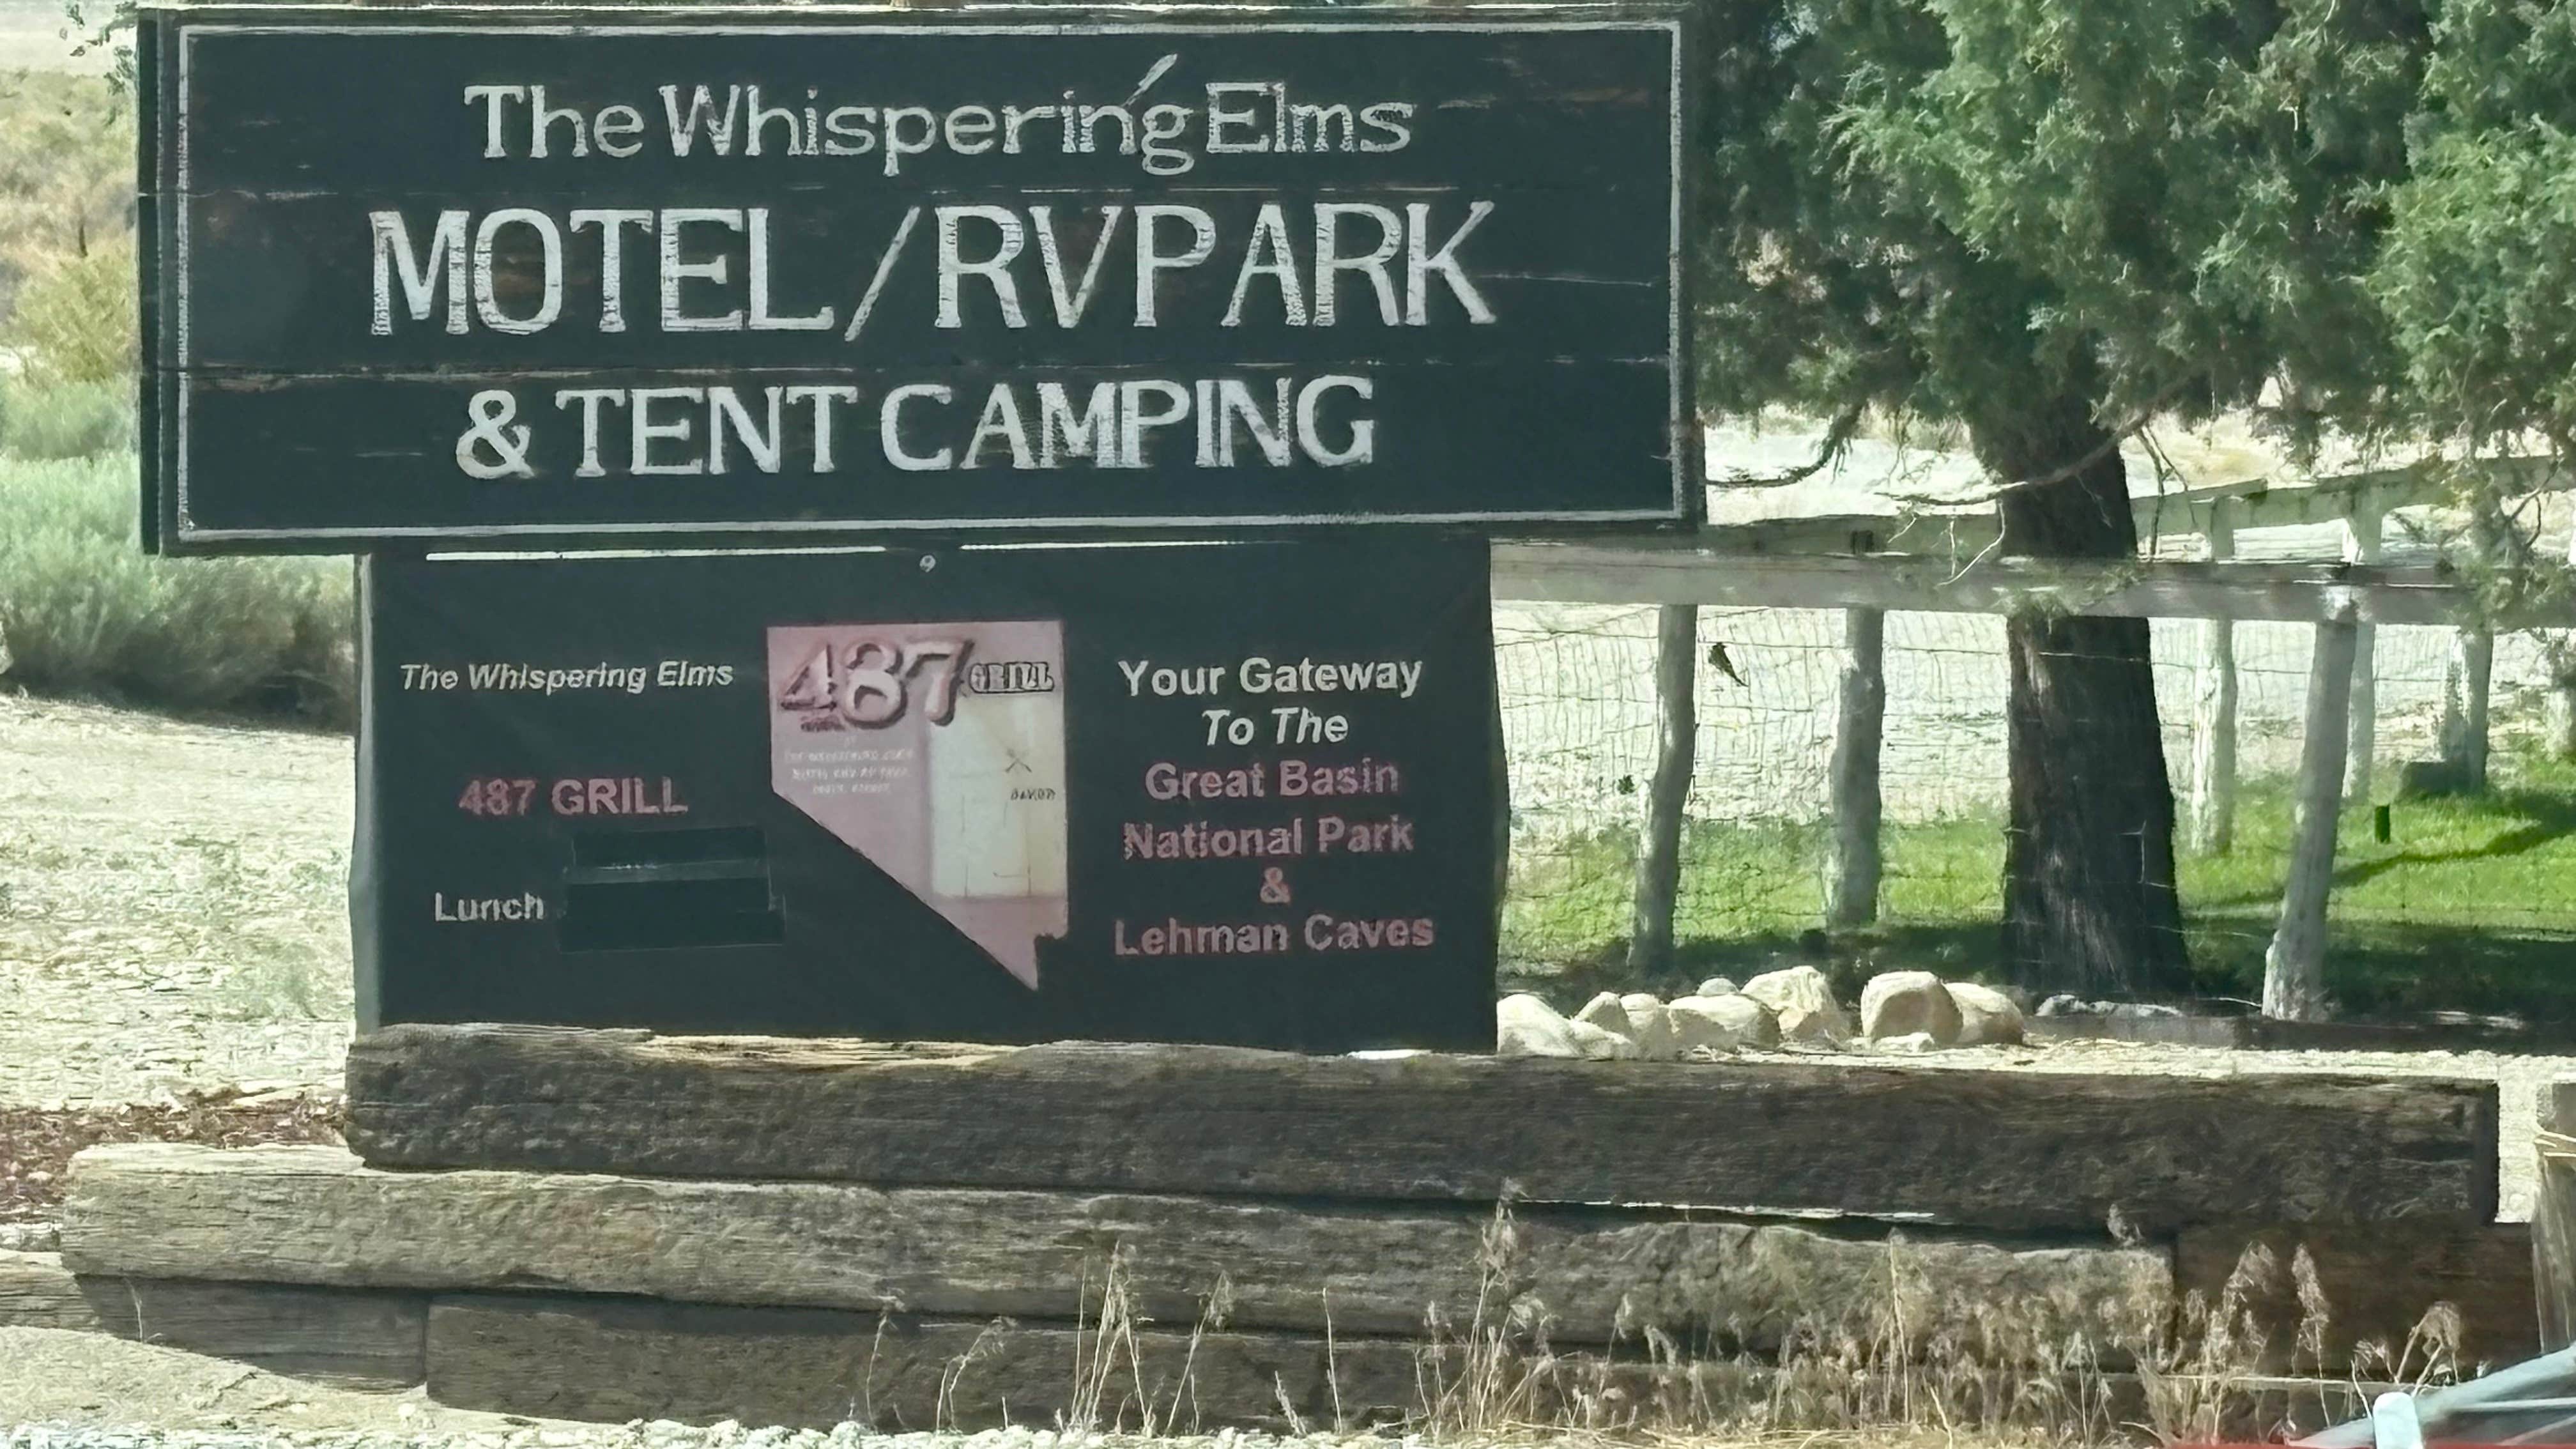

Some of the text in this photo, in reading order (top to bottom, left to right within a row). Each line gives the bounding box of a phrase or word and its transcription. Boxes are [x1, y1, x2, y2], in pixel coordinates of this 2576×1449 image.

[464, 84, 645, 158] The
[1205, 81, 1417, 154] Elms
[456, 374, 1374, 479] & TENT CAMPING
[400, 661, 733, 696] The Whispering Elms
[781, 641, 1054, 727] 487 GRILL
[1117, 657, 1423, 698] Your Gateway
[1202, 707, 1349, 746] To The
[458, 777, 689, 816] 487 GRILL
[1146, 757, 1399, 801] Great Basin
[1124, 814, 1413, 860] National Park
[1260, 867, 1291, 903] &
[435, 892, 544, 922] Lunch
[1115, 914, 1434, 955] Lehman Caves
